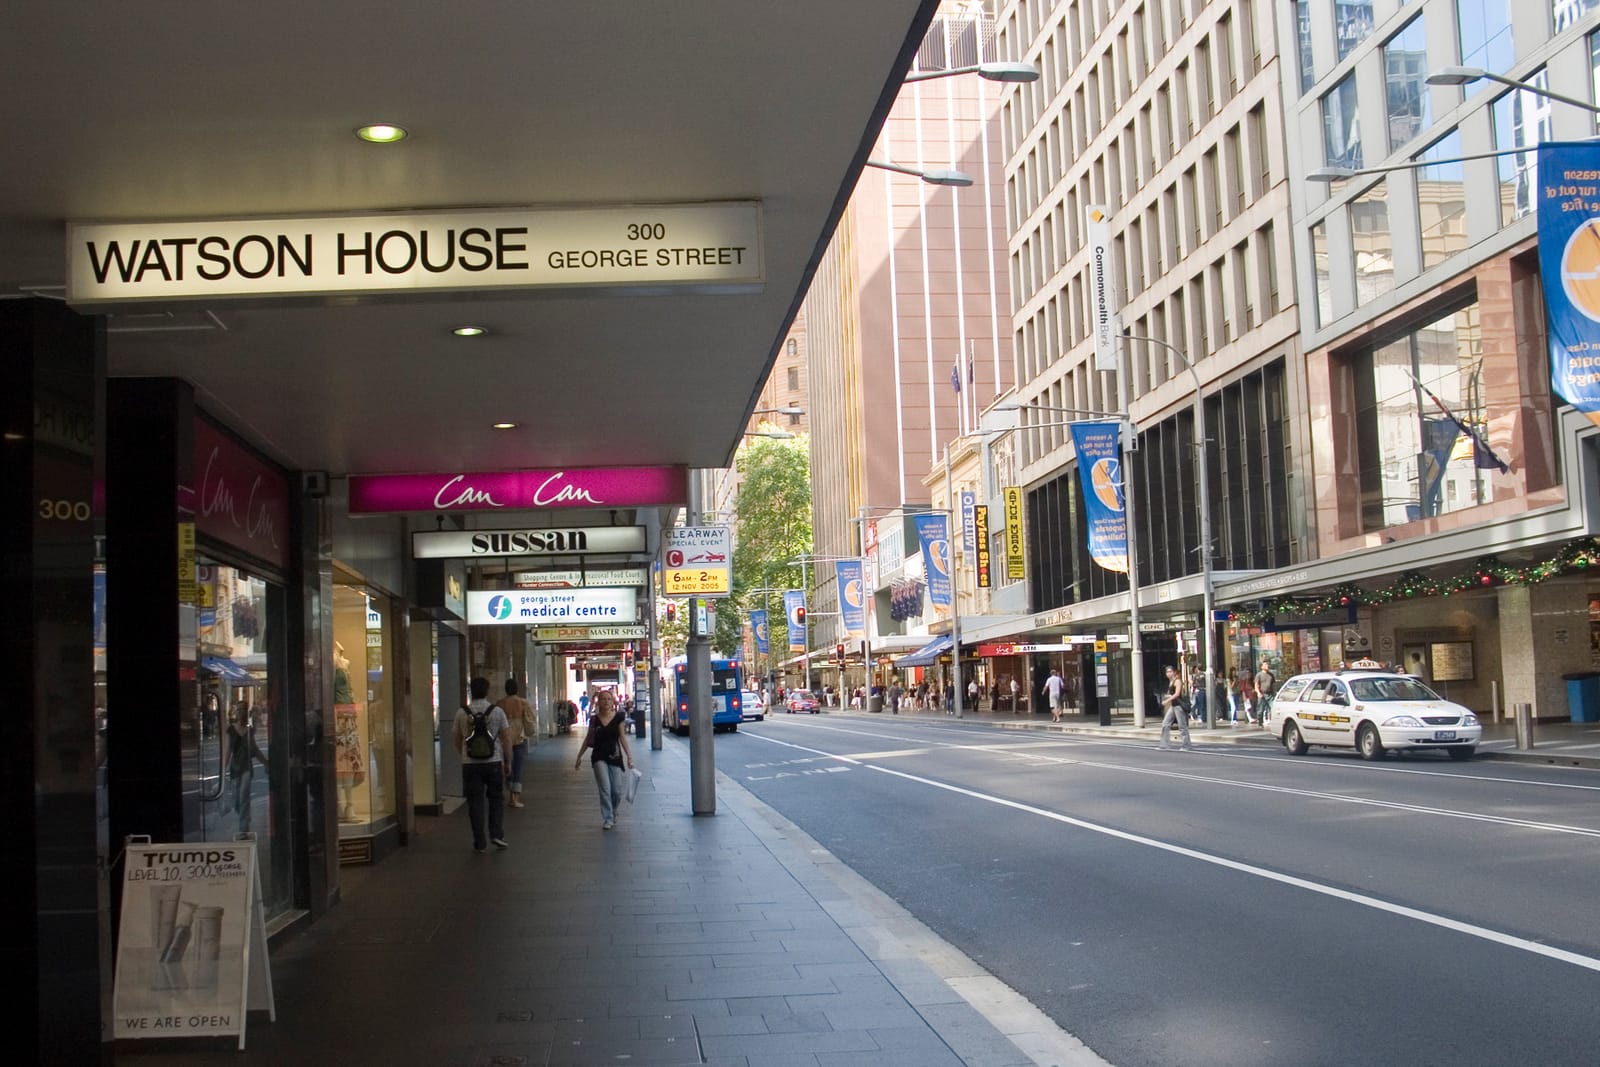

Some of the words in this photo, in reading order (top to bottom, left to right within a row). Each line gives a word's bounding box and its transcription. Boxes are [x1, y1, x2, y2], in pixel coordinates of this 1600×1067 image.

[627, 223, 665, 241] 300
[86, 233, 313, 284] WATSON
[337, 226, 529, 275] HOUSE
[547, 249, 649, 269] GEORGE
[656, 246, 746, 266] STREET
[1095, 246, 1109, 324] Commonwealth
[434, 475, 505, 509] Can
[533, 472, 604, 506] Can
[39, 500, 91, 521] 300
[664, 529, 725, 539] CLEARWAY
[976, 506, 988, 550] Payless
[471, 530, 588, 554] sussan
[669, 551, 681, 567] C
[979, 551, 990, 587] Shoes
[520, 595, 548, 605] george
[520, 607, 570, 617] medical
[575, 605, 617, 616] centre
[558, 628, 589, 637] pure
[590, 627, 619, 636] MASTER
[622, 626, 644, 635] SPECS
[143, 850, 236, 868] Trumps
[128, 869, 159, 881] LEVEL
[187, 865, 212, 879] 300
[126, 1018, 148, 1029] WE
[153, 1017, 182, 1028] ARE
[188, 1016, 231, 1028] OPEN
